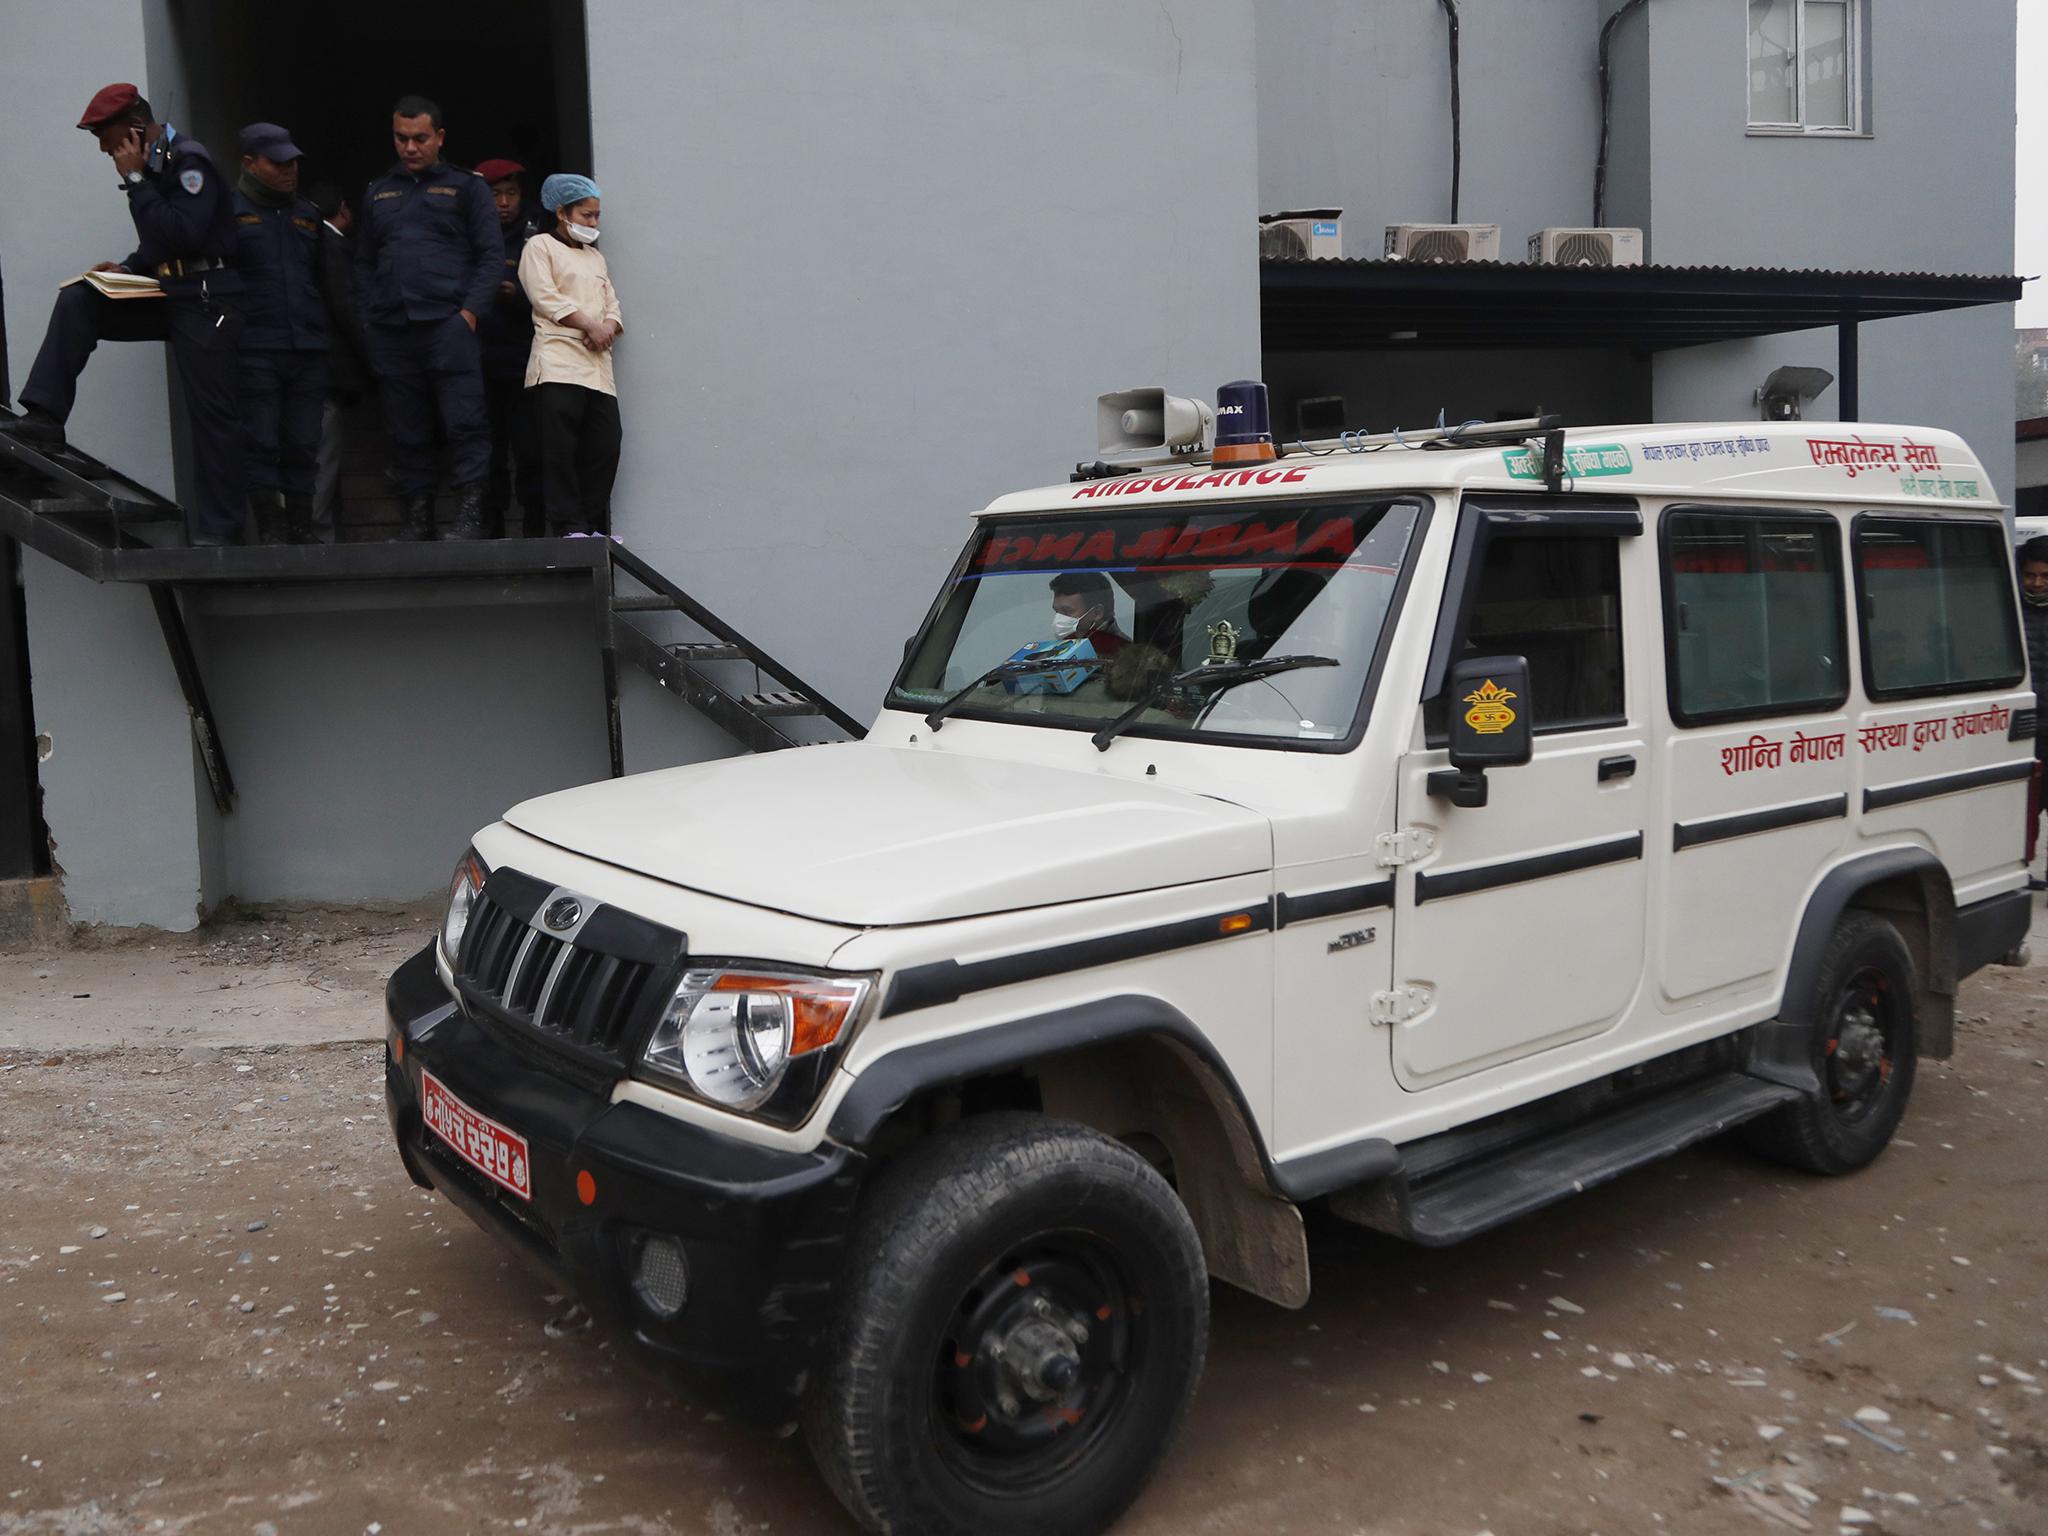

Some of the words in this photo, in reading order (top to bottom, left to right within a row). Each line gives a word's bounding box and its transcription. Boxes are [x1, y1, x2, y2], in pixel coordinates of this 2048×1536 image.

[1901, 436, 1942, 472] सेवा
[1072, 465, 1320, 499] AMBULANCE
[1790, 731, 1846, 763] नेपाल
[1858, 722, 1909, 753] संस्था
